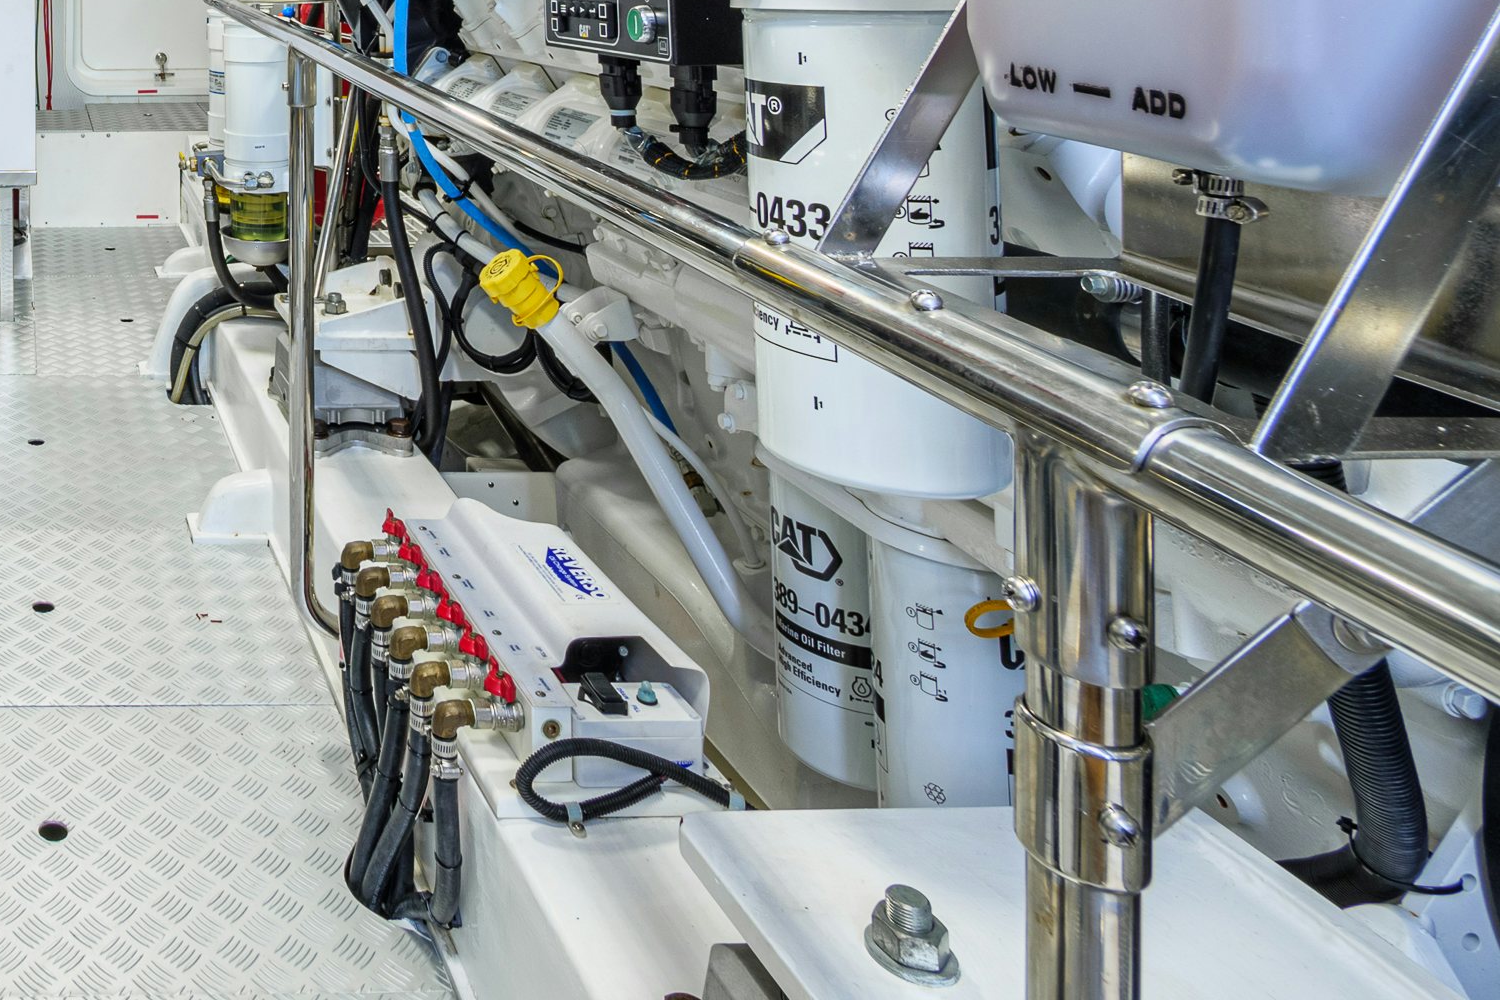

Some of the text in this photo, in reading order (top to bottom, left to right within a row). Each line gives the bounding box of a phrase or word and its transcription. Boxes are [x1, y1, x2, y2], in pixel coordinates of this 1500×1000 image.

[1009, 62, 1187, 120] LOW ADD
[770, 505, 817, 566] CAT
[548, 546, 611, 600] REVERSO
[801, 634, 814, 648] Oil
[817, 641, 846, 659] Filter
[793, 665, 842, 698] Efficiency
